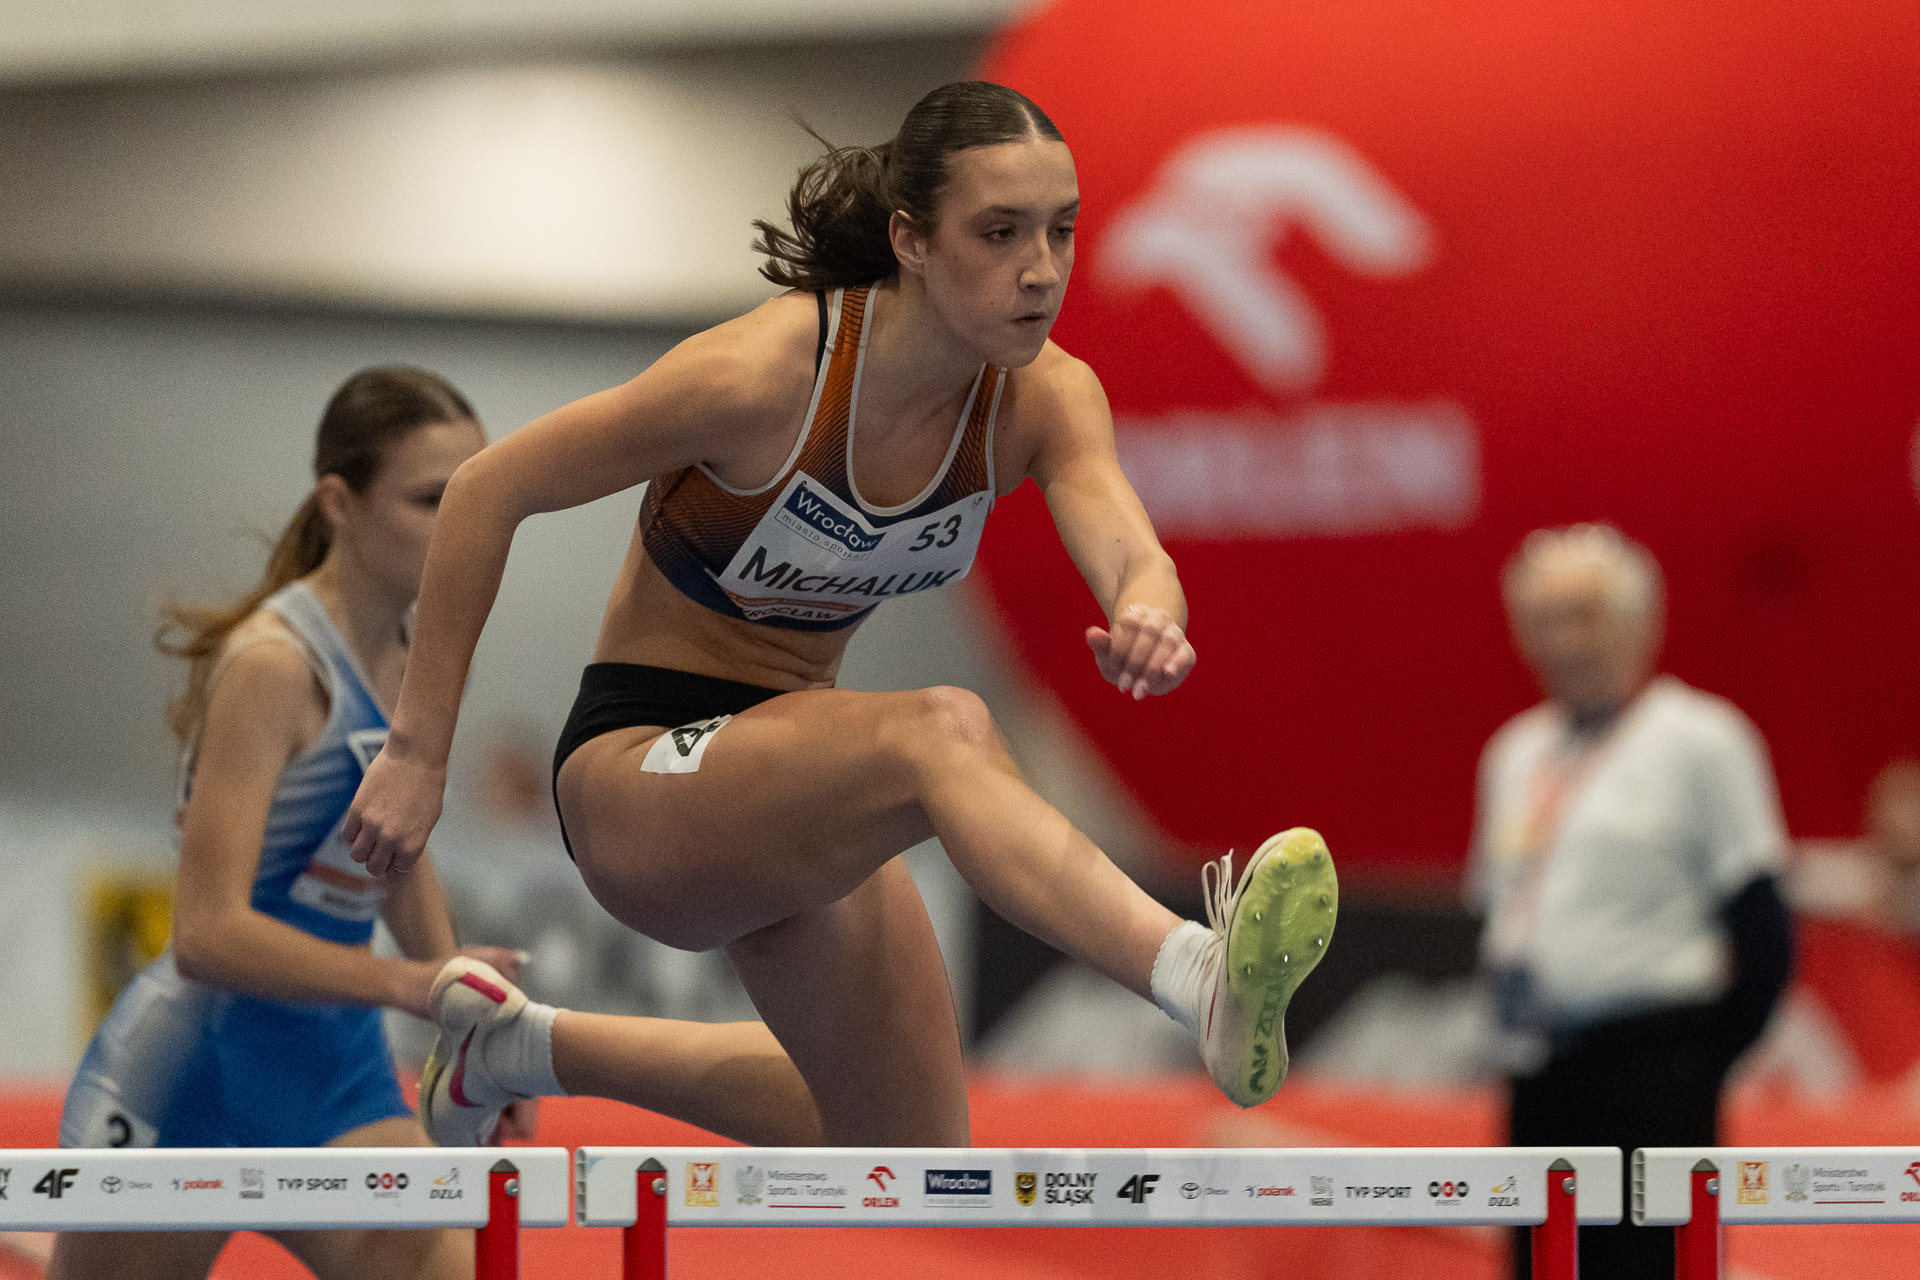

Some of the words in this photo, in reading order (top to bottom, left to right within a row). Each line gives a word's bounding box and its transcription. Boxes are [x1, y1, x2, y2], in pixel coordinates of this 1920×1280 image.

[782, 514, 820, 541] miasto
[797, 491, 878, 548] Wrocław
[908, 514, 962, 552] 53
[738, 546, 961, 597] MICHALUK
[743, 606, 837, 619] ROCŁAW
[33, 1168, 79, 1199] 4F
[277, 1178, 303, 1191] TVP
[306, 1178, 348, 1191] SPORT
[1045, 1172, 1098, 1188] DOLNY
[1116, 1174, 1161, 1204] 4F
[430, 1188, 463, 1199] DZLA
[1045, 1186, 1095, 1206] ŚLĄSK
[1345, 1186, 1369, 1199] TVP
[1372, 1186, 1412, 1199] SPORT
